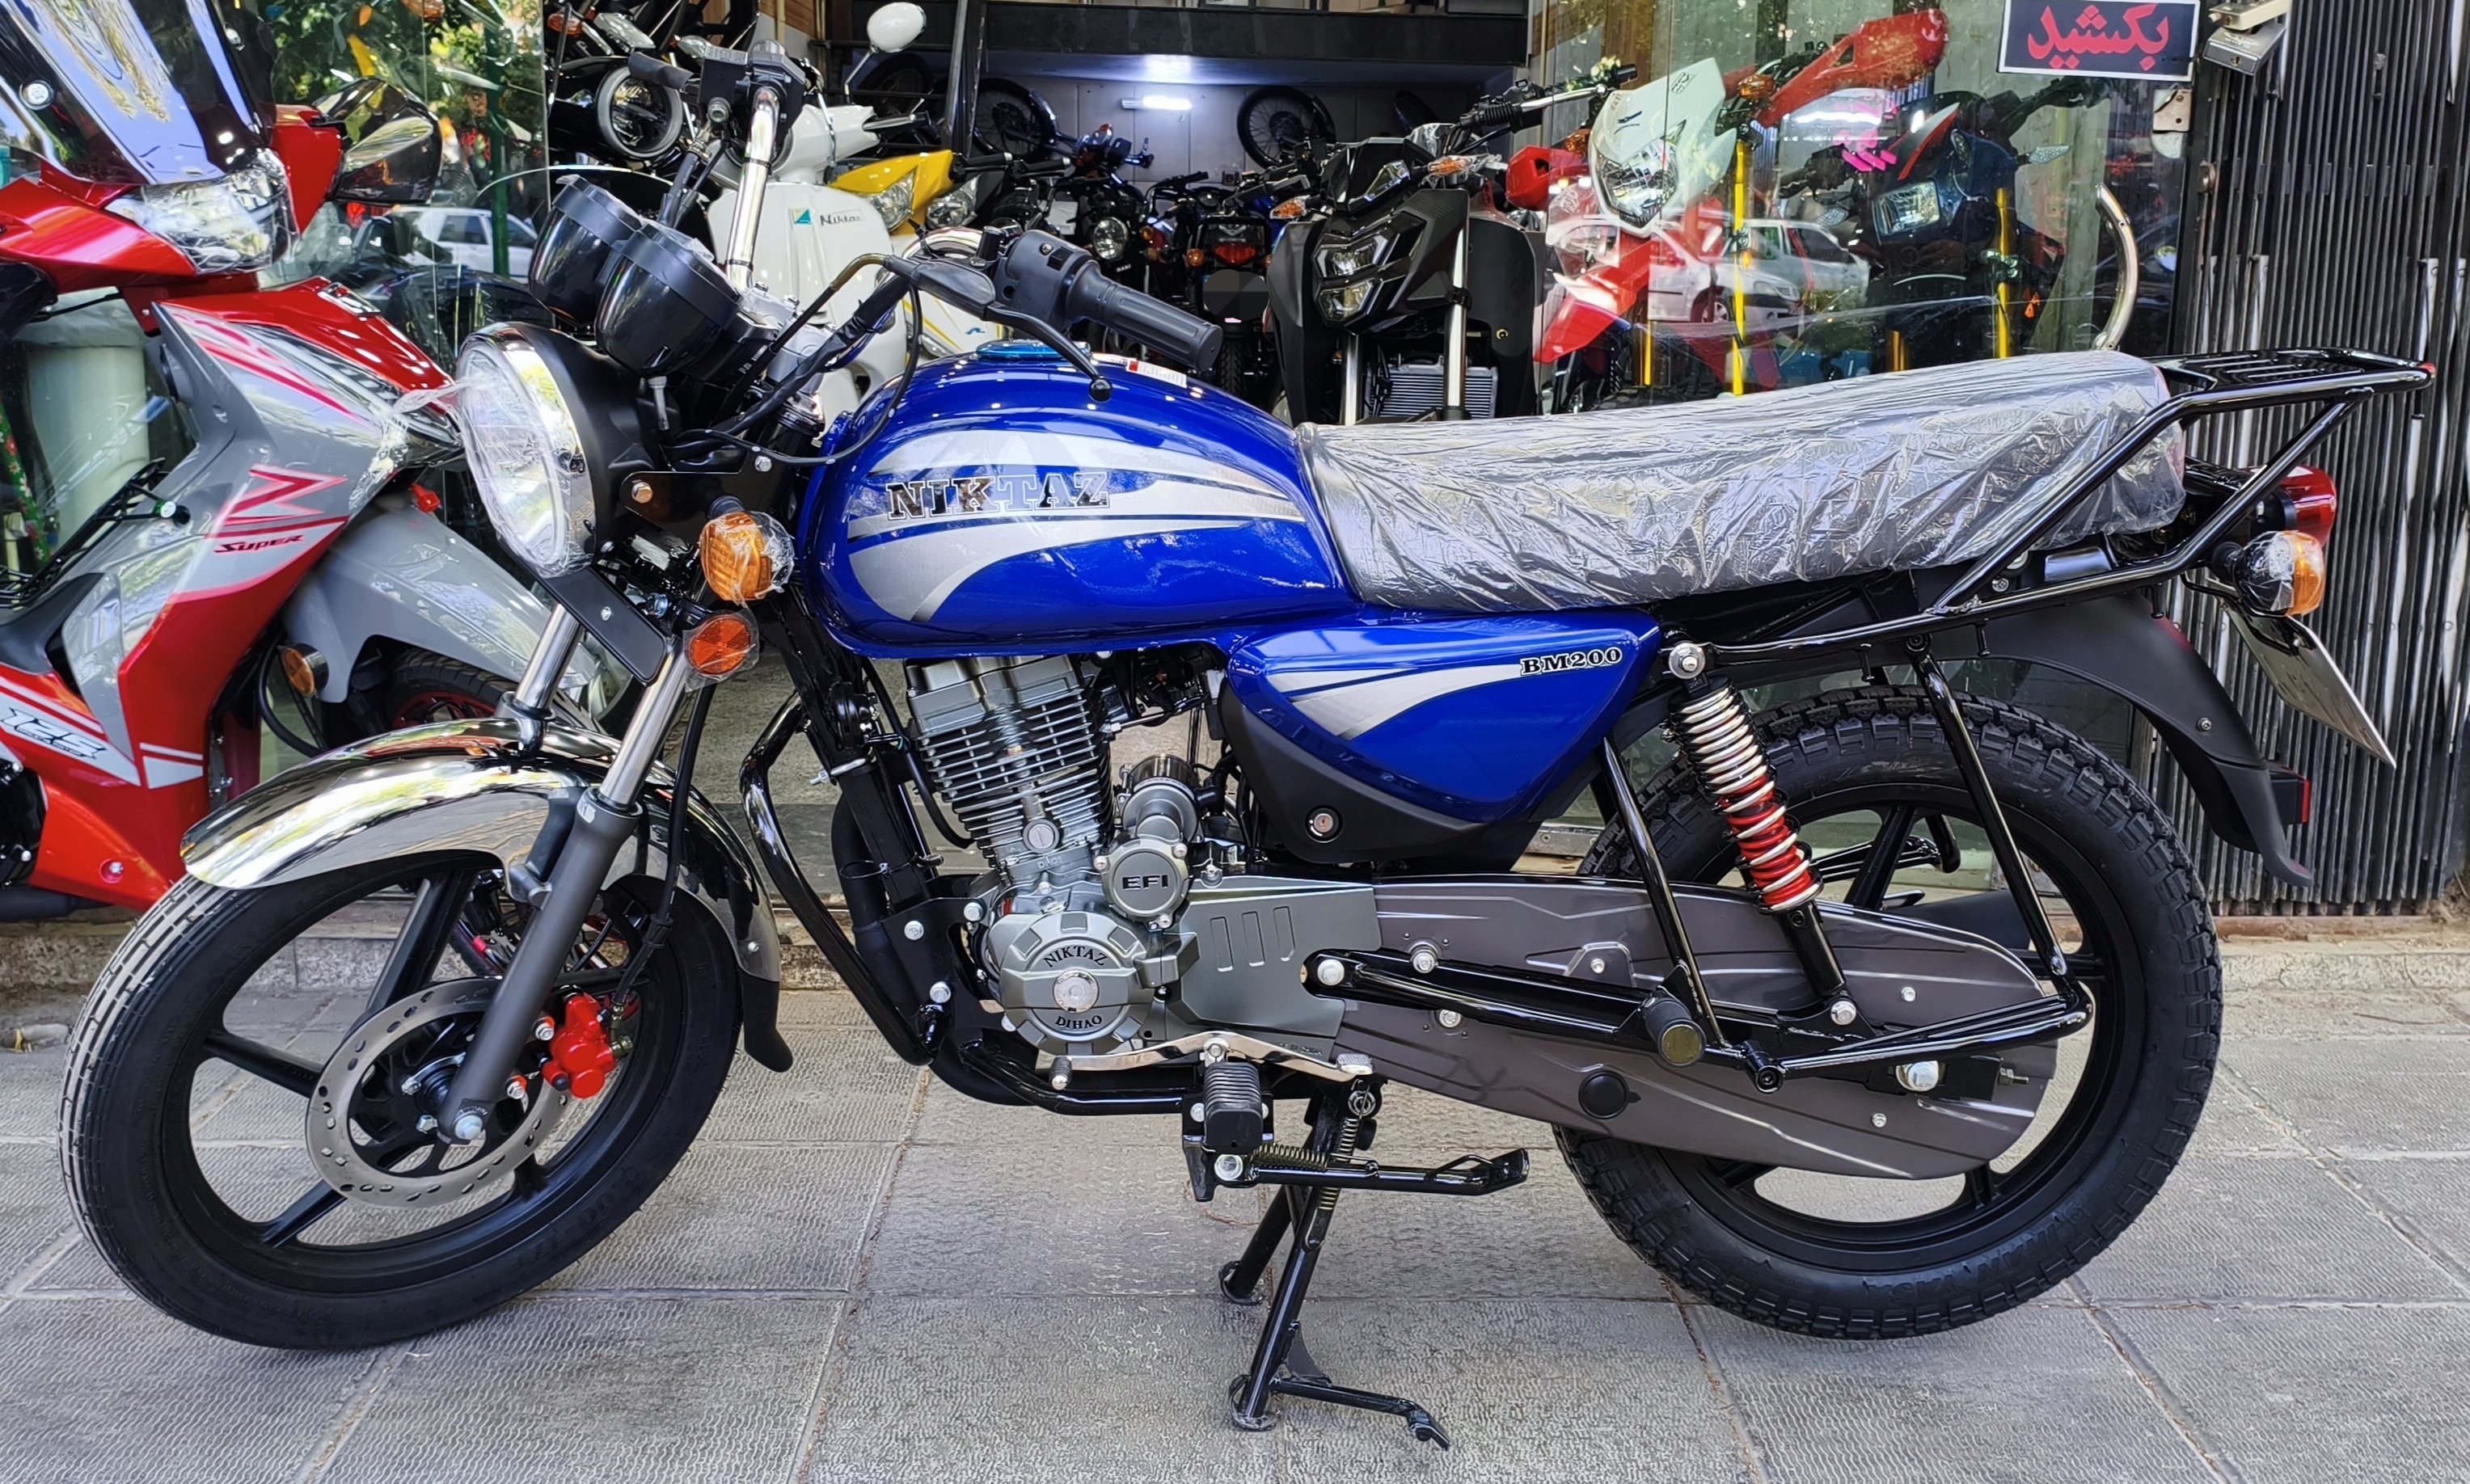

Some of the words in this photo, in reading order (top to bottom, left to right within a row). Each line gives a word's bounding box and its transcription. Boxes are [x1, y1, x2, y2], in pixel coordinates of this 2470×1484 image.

[2028, 3, 2169, 71] بکشید
[885, 472, 1110, 521] NIKTAZ
[1520, 647, 1623, 677] BM200
[1, 706, 108, 760] 125
[1122, 875, 1168, 890] EFI
[1043, 944, 1109, 968] NIKTAZ
[1054, 1014, 1103, 1030] DIHAO
